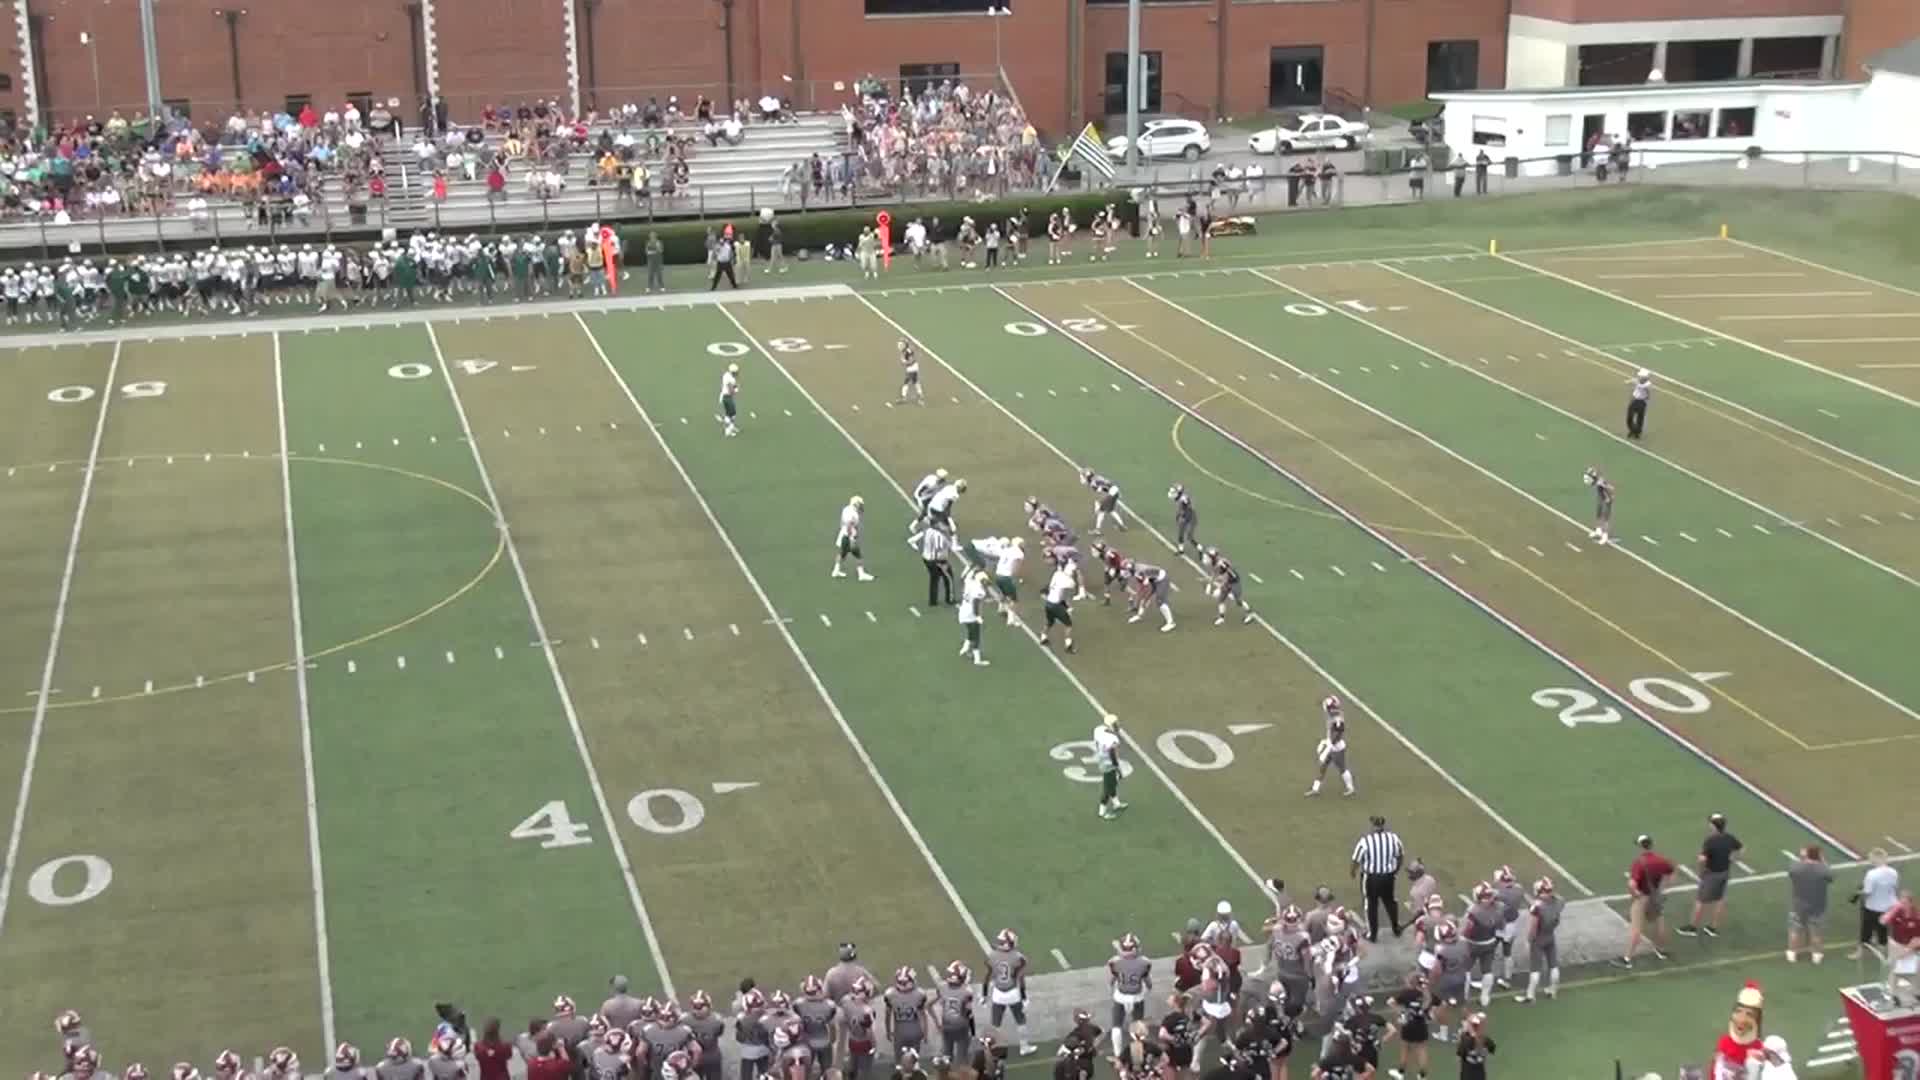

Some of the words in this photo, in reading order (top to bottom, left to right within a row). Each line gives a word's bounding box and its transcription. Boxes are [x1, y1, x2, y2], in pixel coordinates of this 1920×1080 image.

[706, 337, 813, 357] 30
[388, 359, 498, 379] 40
[48, 381, 167, 402] 50
[1531, 677, 1711, 728] 20
[510, 788, 704, 849] 40
